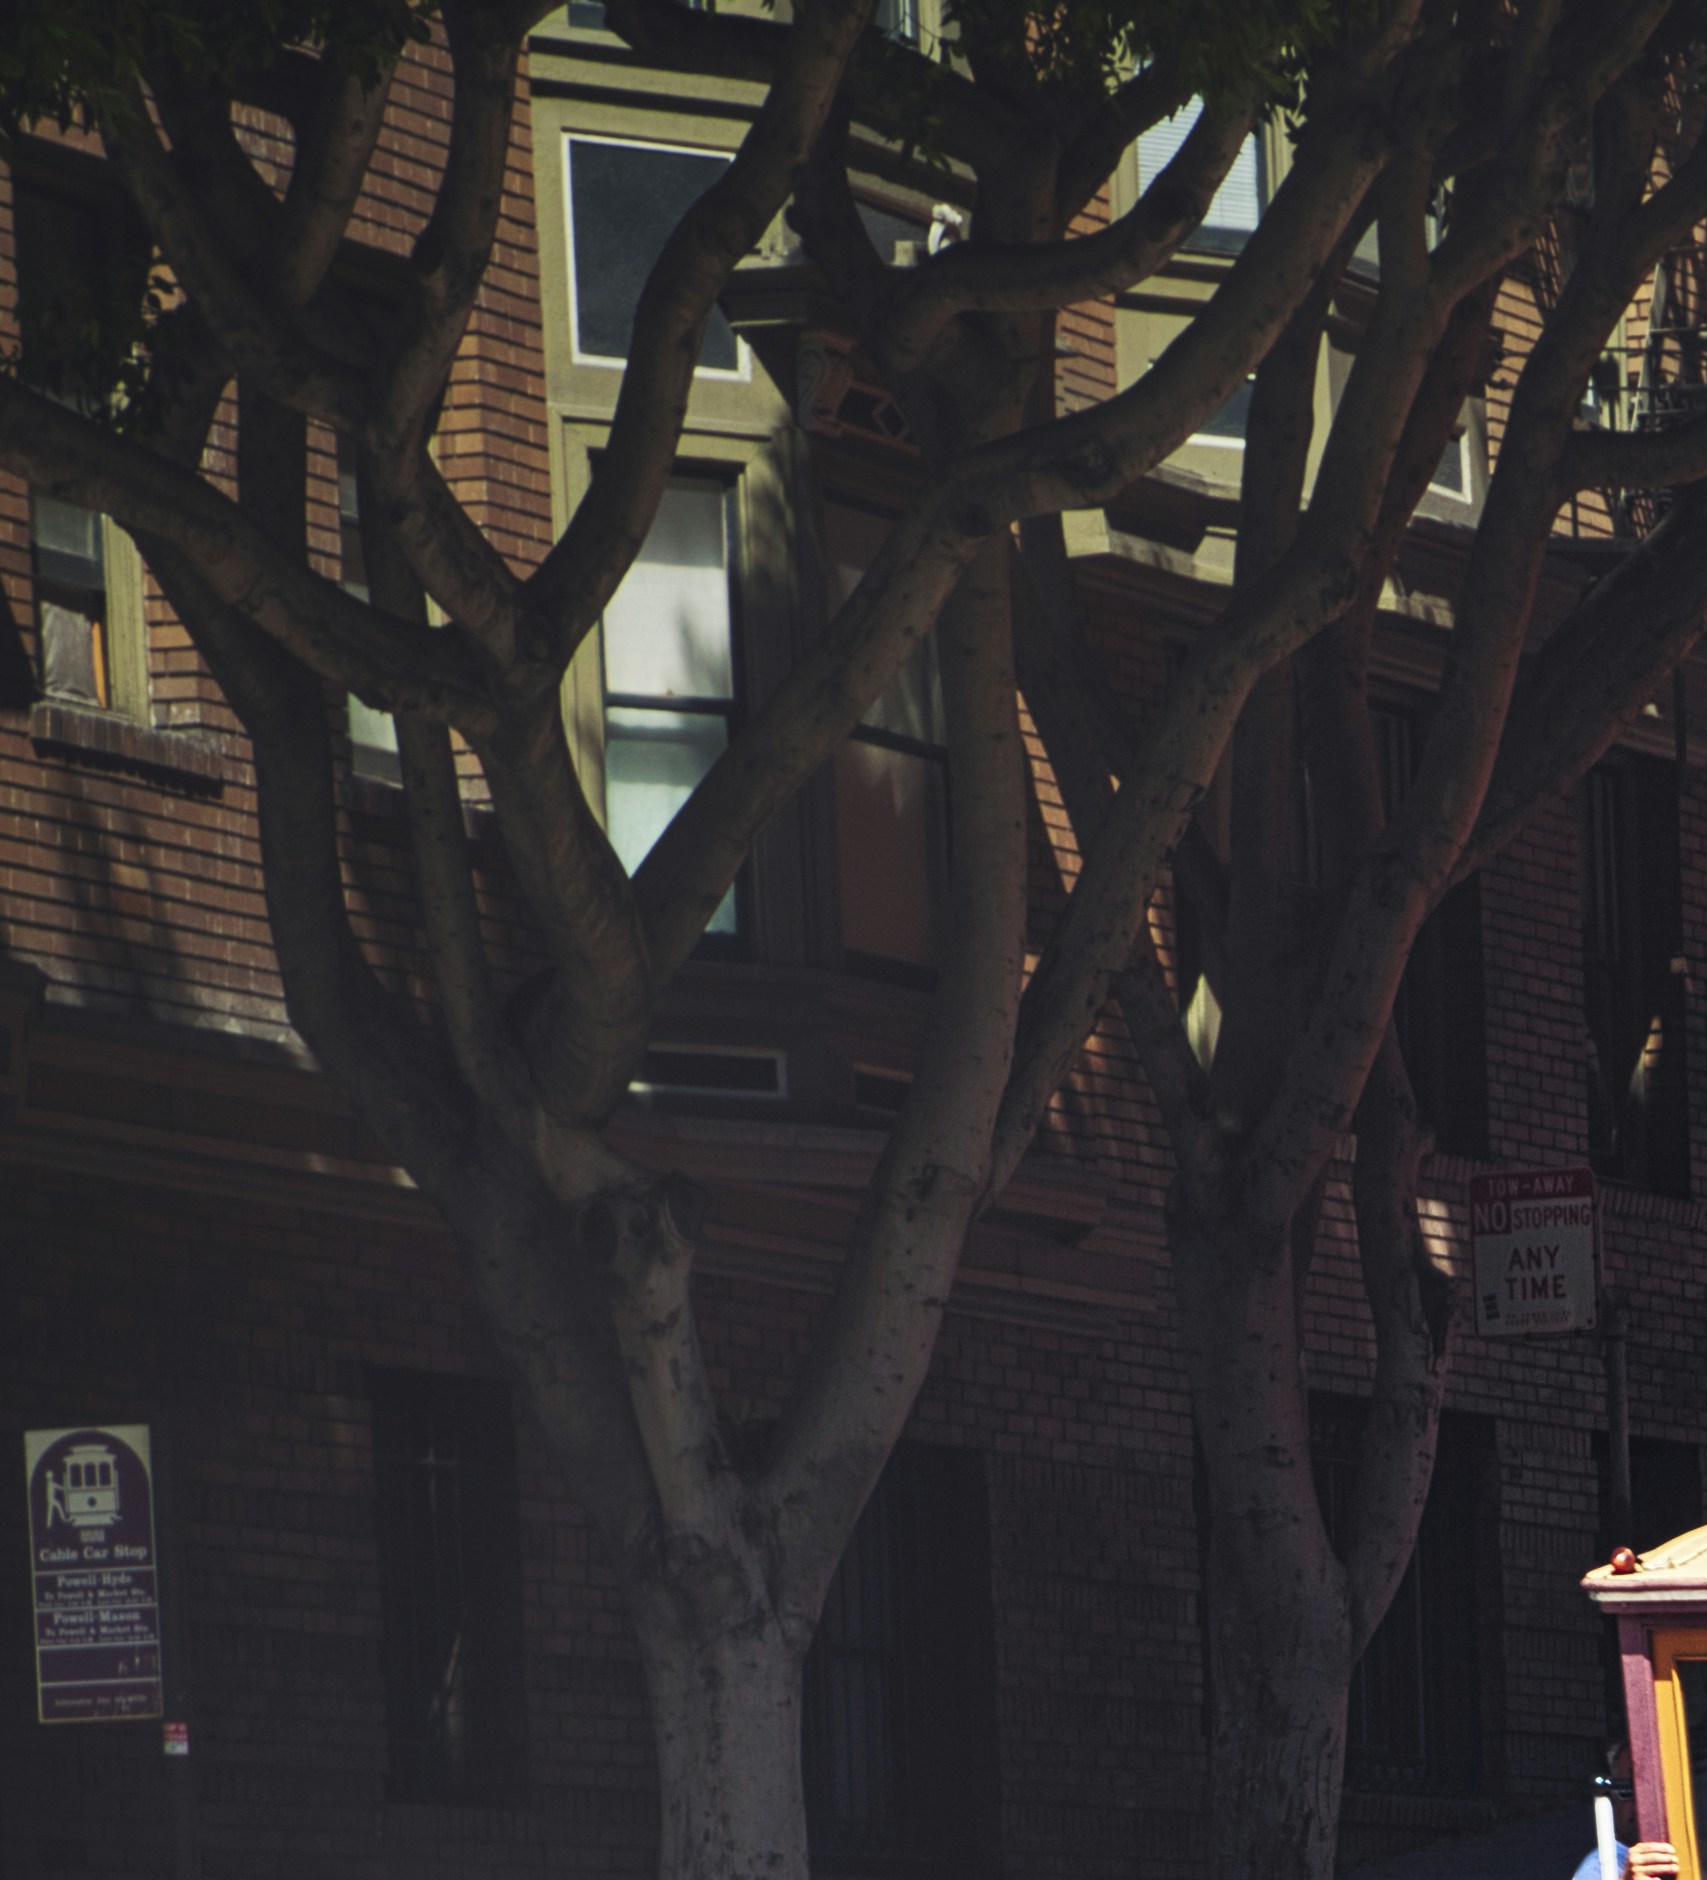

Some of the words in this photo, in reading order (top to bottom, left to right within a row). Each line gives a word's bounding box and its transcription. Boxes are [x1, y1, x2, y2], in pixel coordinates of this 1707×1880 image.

[1487, 1175, 1574, 1198] TOW-AWAY
[1473, 1202, 1507, 1233] NO
[1512, 1203, 1591, 1230] STOPPING
[1508, 1244, 1560, 1271] ANY
[1504, 1274, 1567, 1301] TIME
[39, 1547, 79, 1562] Cable
[83, 1545, 109, 1559] Car
[113, 1544, 148, 1562] Stop
